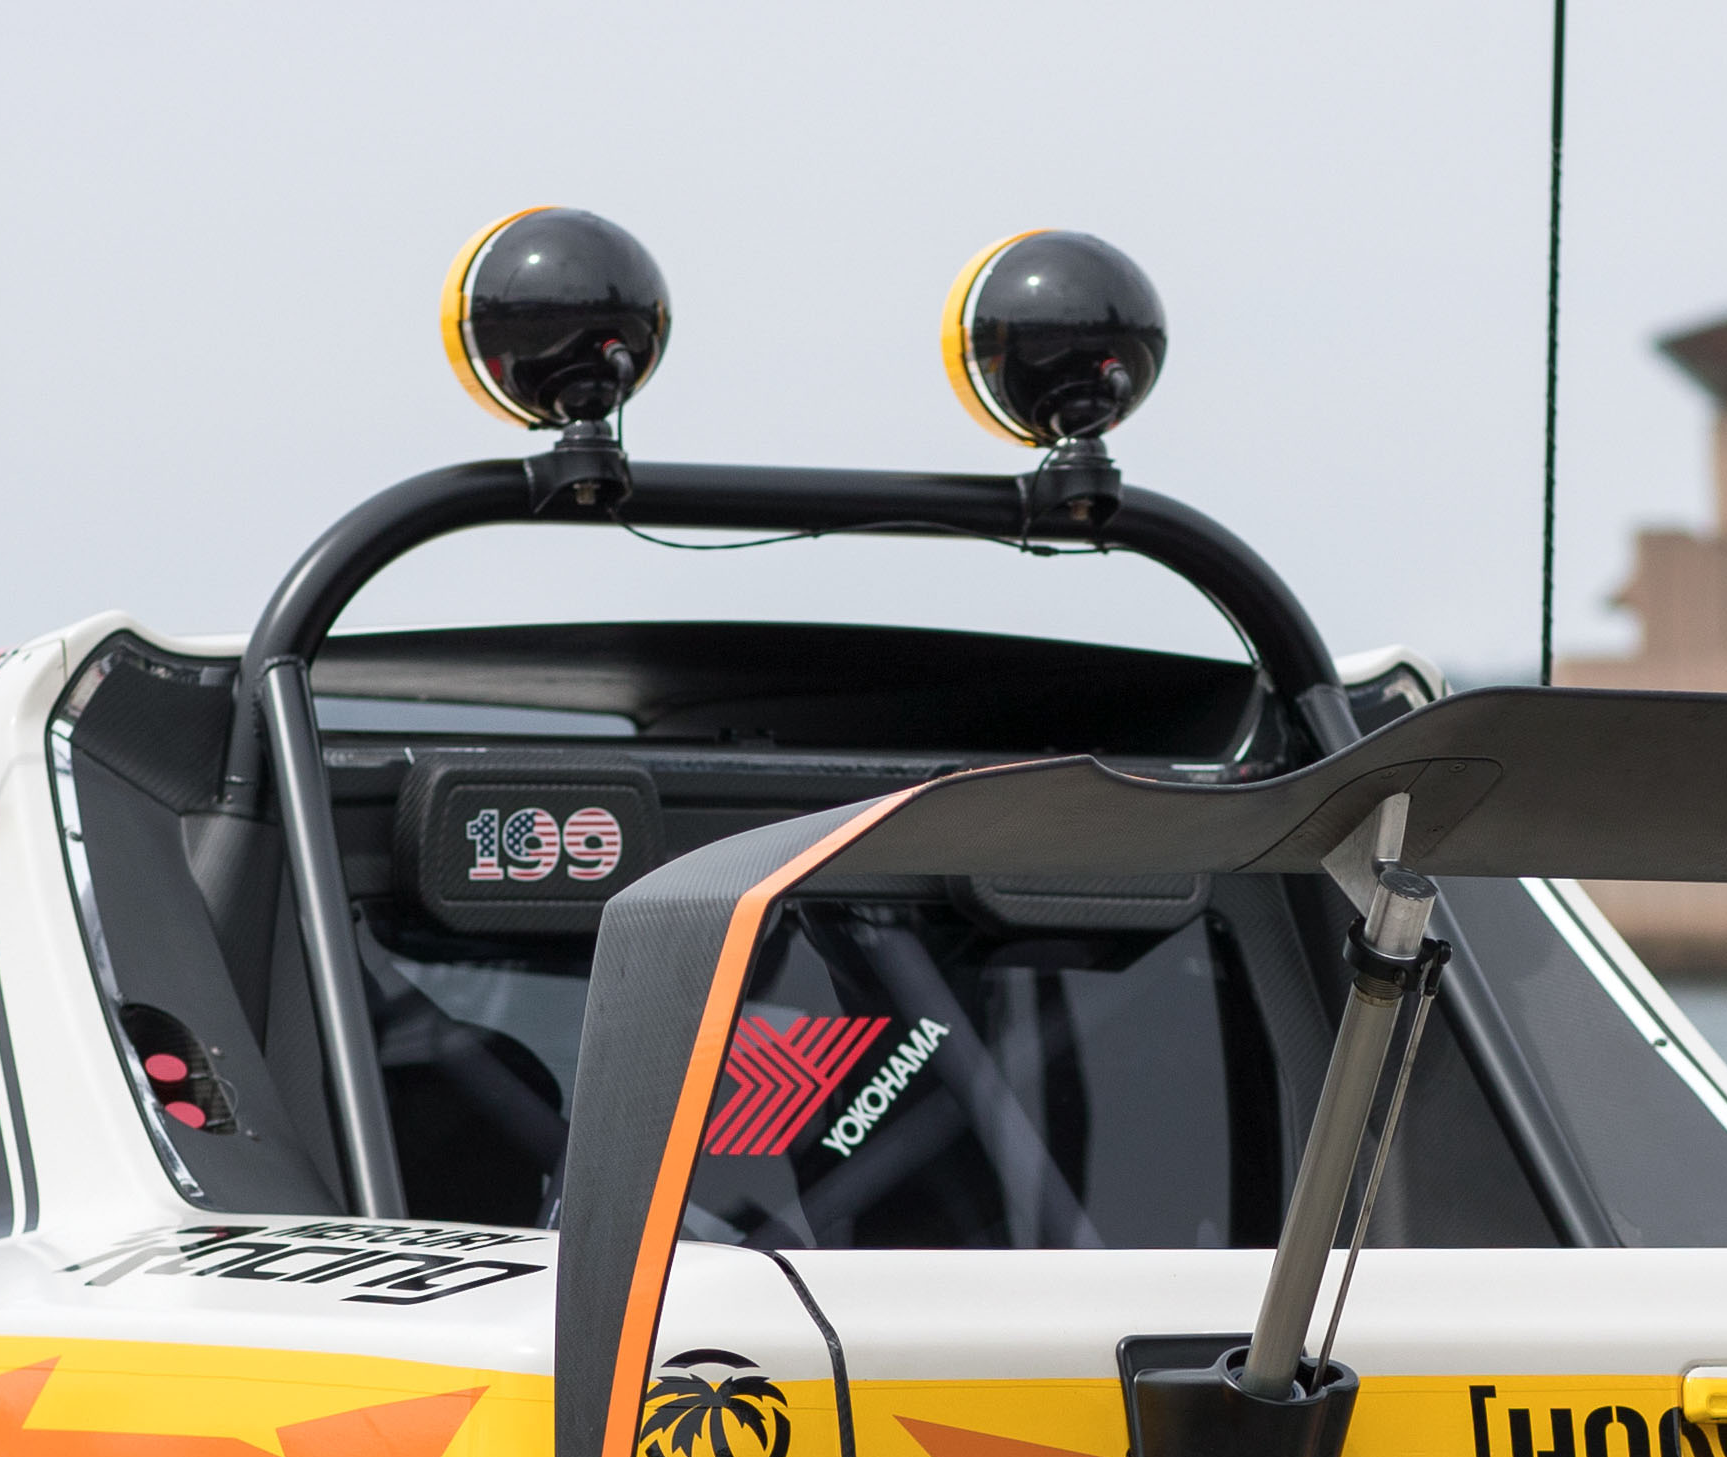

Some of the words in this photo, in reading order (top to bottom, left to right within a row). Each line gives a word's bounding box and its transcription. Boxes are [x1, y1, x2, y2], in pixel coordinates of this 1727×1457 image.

[466, 806, 623, 881] 199
[822, 1016, 949, 1158] YOKOHAMA
[267, 1222, 549, 1250] MERCURY
